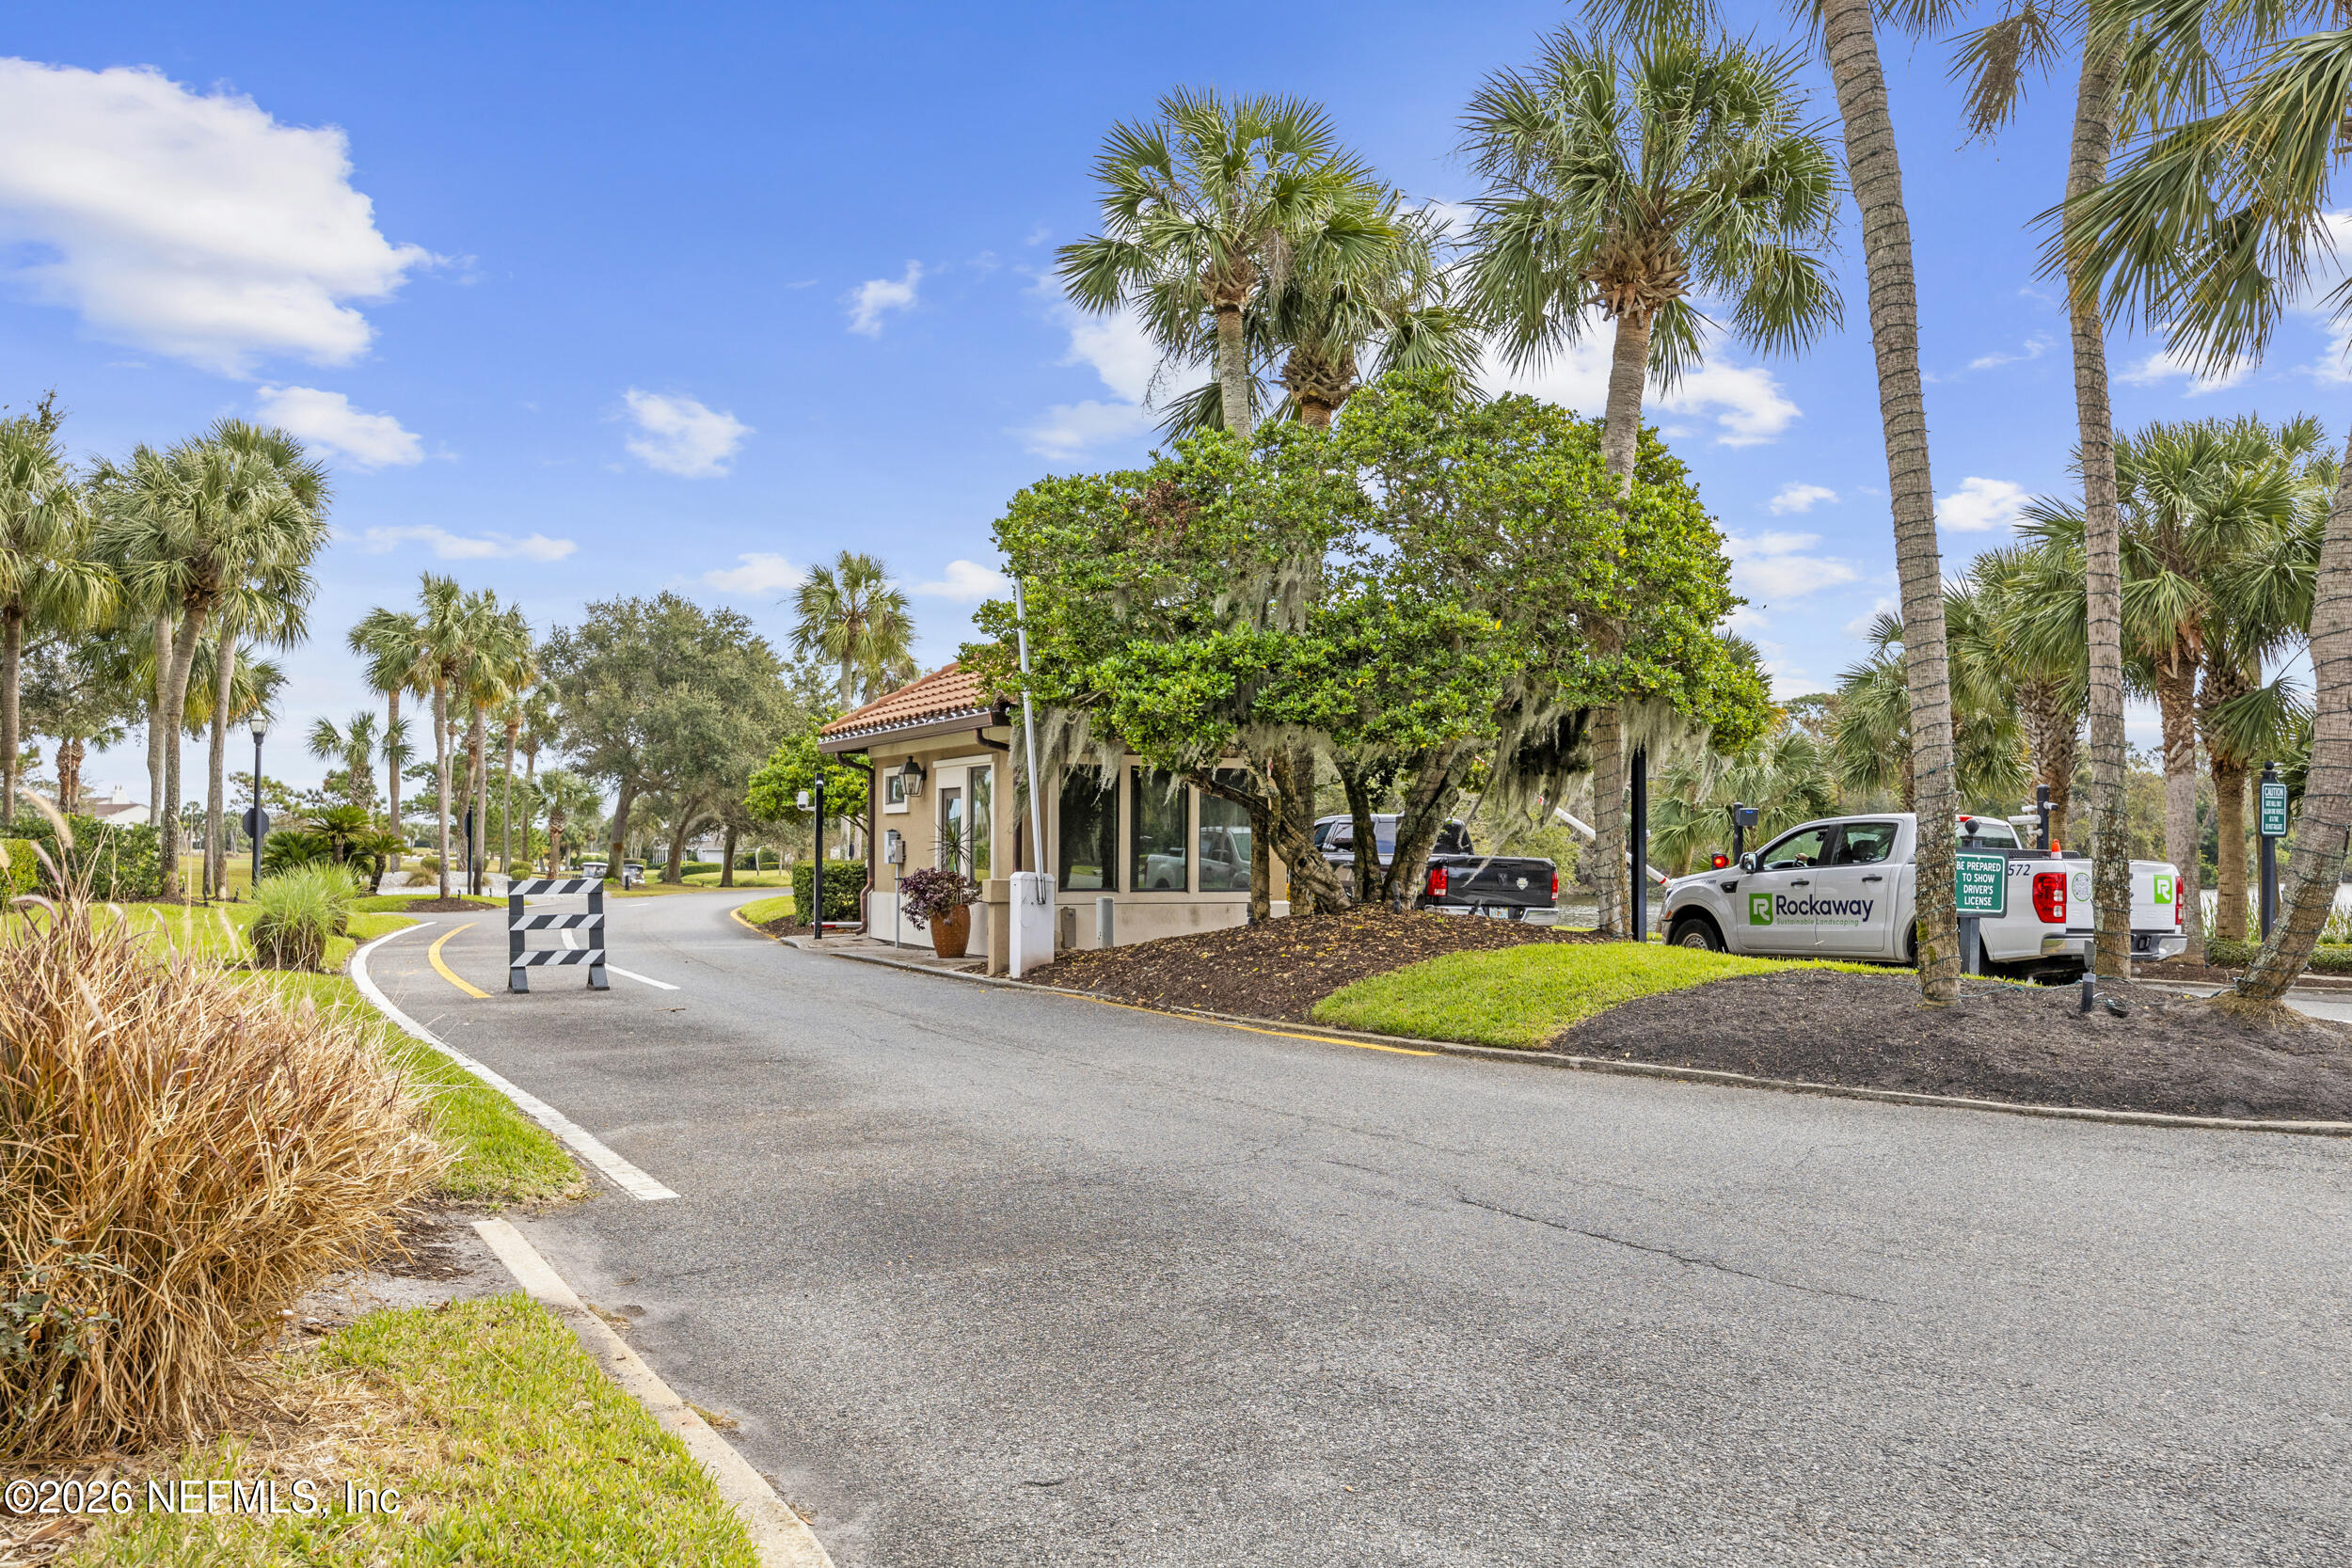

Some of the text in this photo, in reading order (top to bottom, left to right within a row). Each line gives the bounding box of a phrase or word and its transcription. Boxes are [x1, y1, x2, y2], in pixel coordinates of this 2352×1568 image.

[2265, 787, 2283, 797] CAUTION
[1956, 861, 2001, 872] BE PREPARED
[2007, 863, 2031, 877] 572
[1962, 873, 1994, 883] TO SHOW
[1963, 884, 1994, 895] DRIVER'S
[1963, 896, 1992, 906] LICENSE
[1775, 894, 1874, 922] Rockaway
[1776, 917, 1859, 927] Sustainable Landscaping
